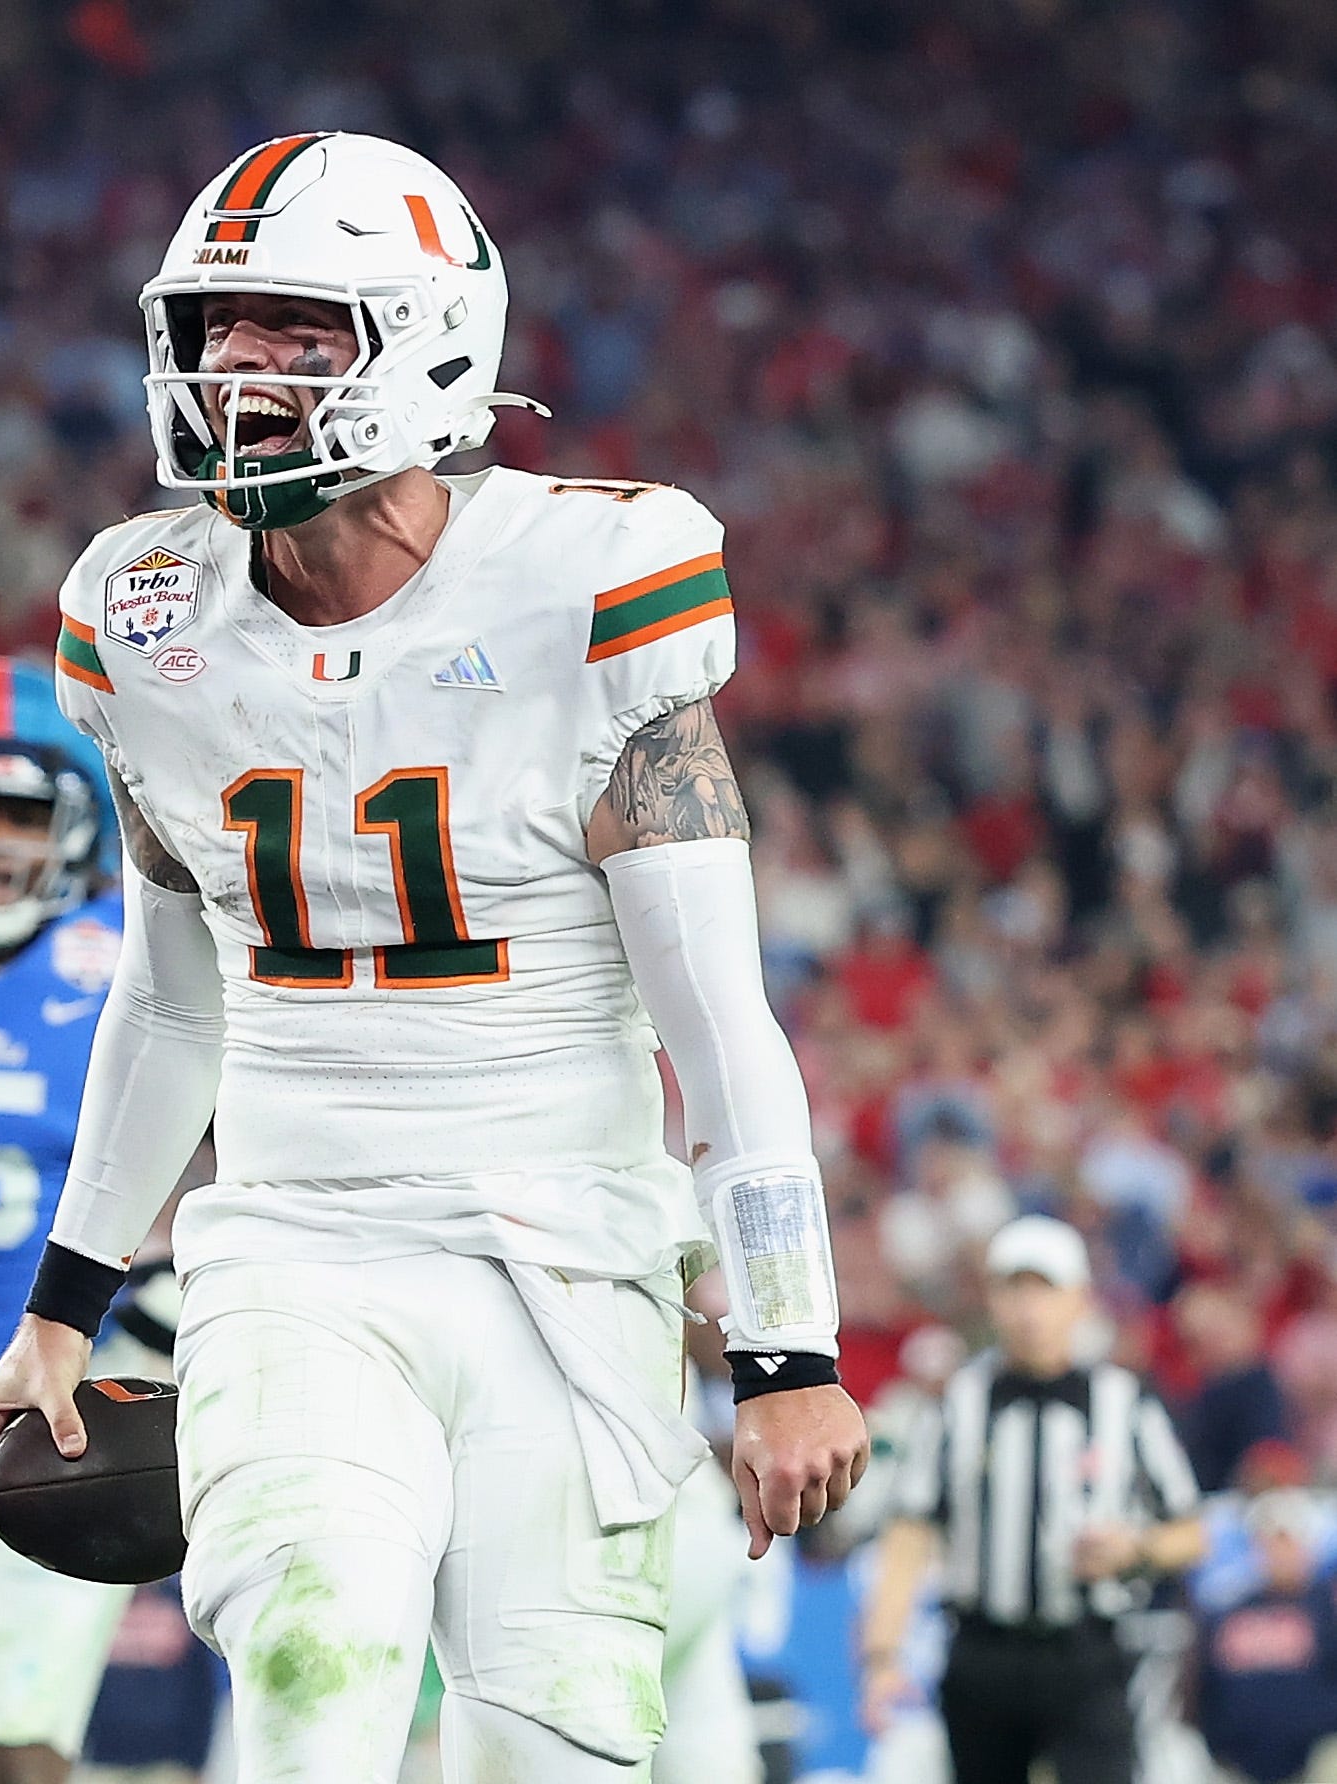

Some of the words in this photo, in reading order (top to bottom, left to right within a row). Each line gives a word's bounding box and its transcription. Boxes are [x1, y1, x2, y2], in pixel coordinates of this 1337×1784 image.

[129, 571, 179, 592] Vrbo
[108, 595, 151, 616] Fiesta
[154, 590, 194, 604] Bowl
[161, 655, 199, 667] ACC
[312, 651, 361, 681] U
[220, 766, 510, 989] 11
